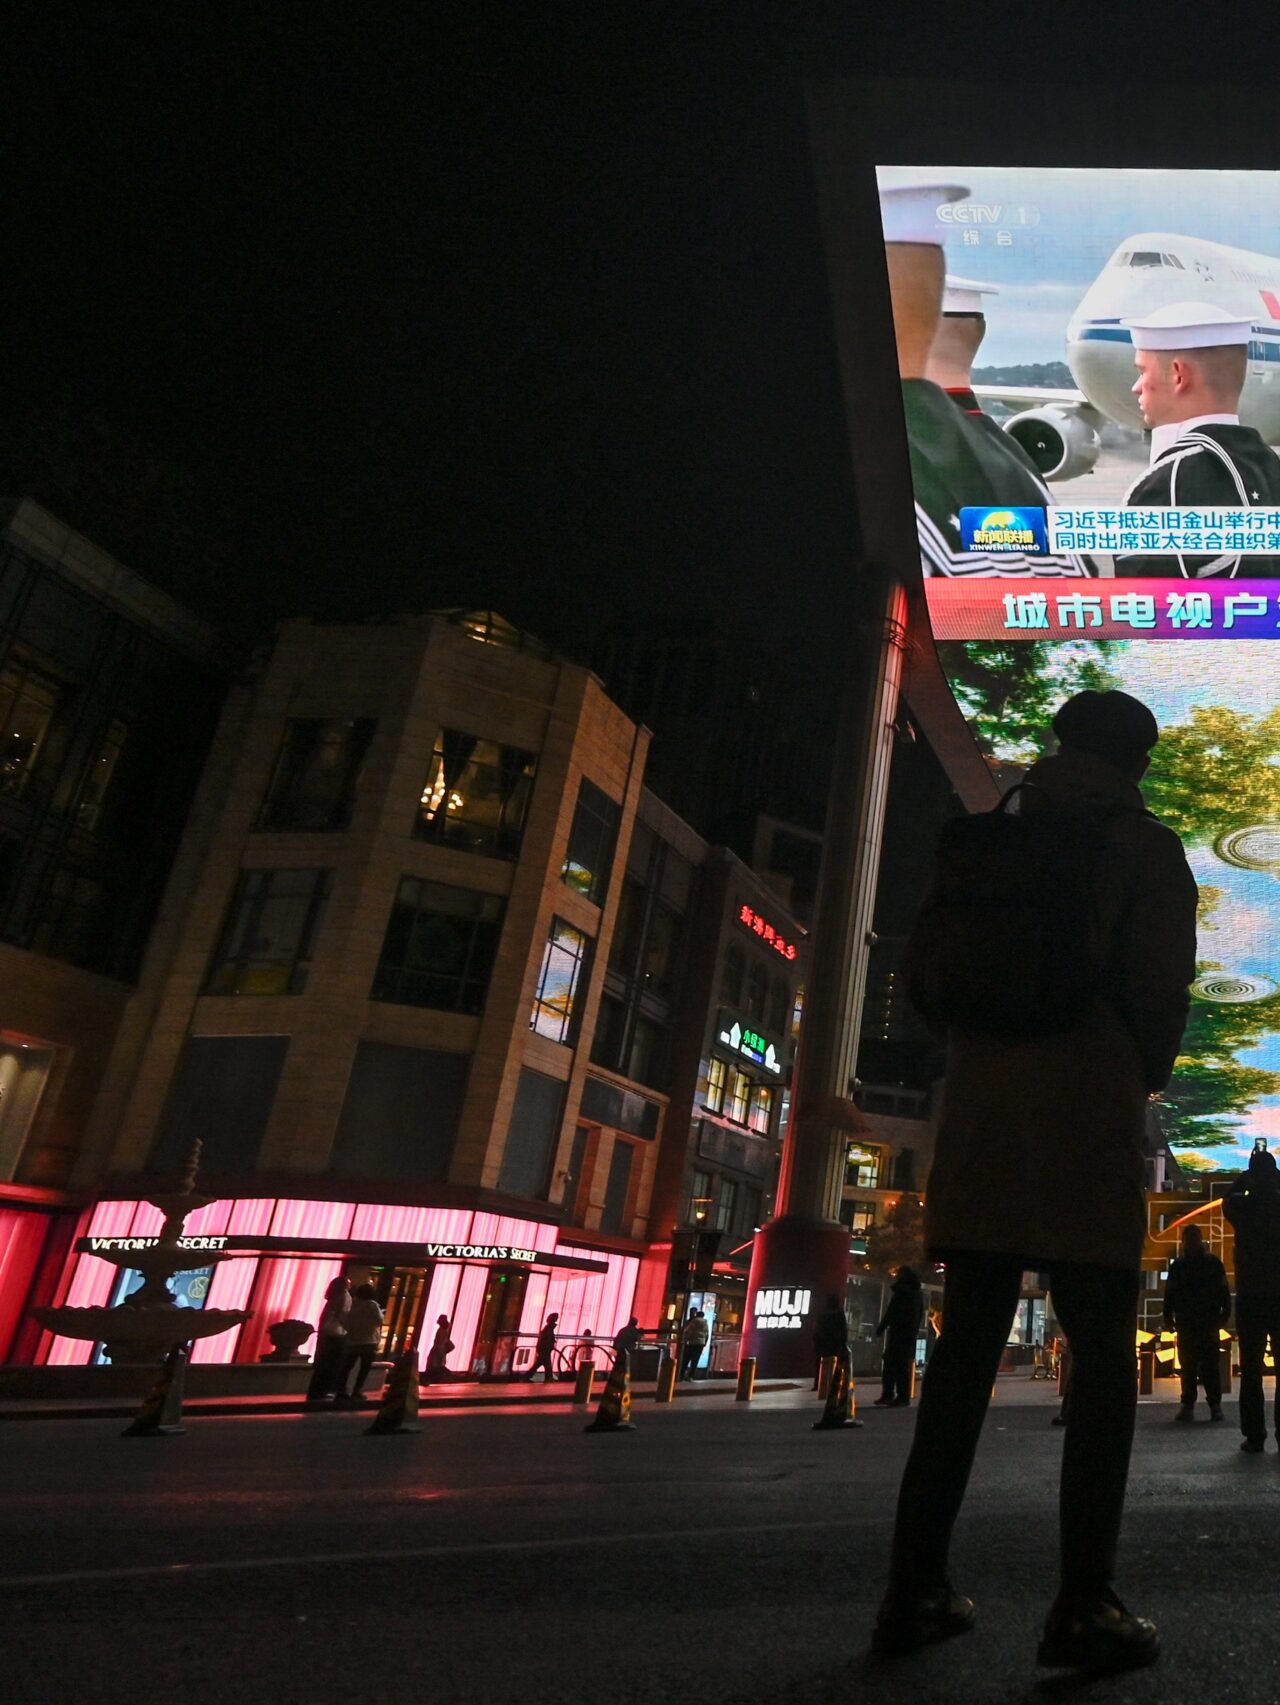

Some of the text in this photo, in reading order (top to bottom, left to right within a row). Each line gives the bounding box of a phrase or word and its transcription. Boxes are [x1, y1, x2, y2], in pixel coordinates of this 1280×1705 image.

[935, 203, 1002, 224] CCTV
[962, 230, 1013, 246] 综合
[973, 529, 1034, 544] 新闻联播
[1008, 543, 1040, 551] LIANBO
[91, 1238, 160, 1251] VICTORI
[427, 1244, 537, 1262] VICTORIA'S SECRET
[754, 1290, 811, 1316] MUJI
